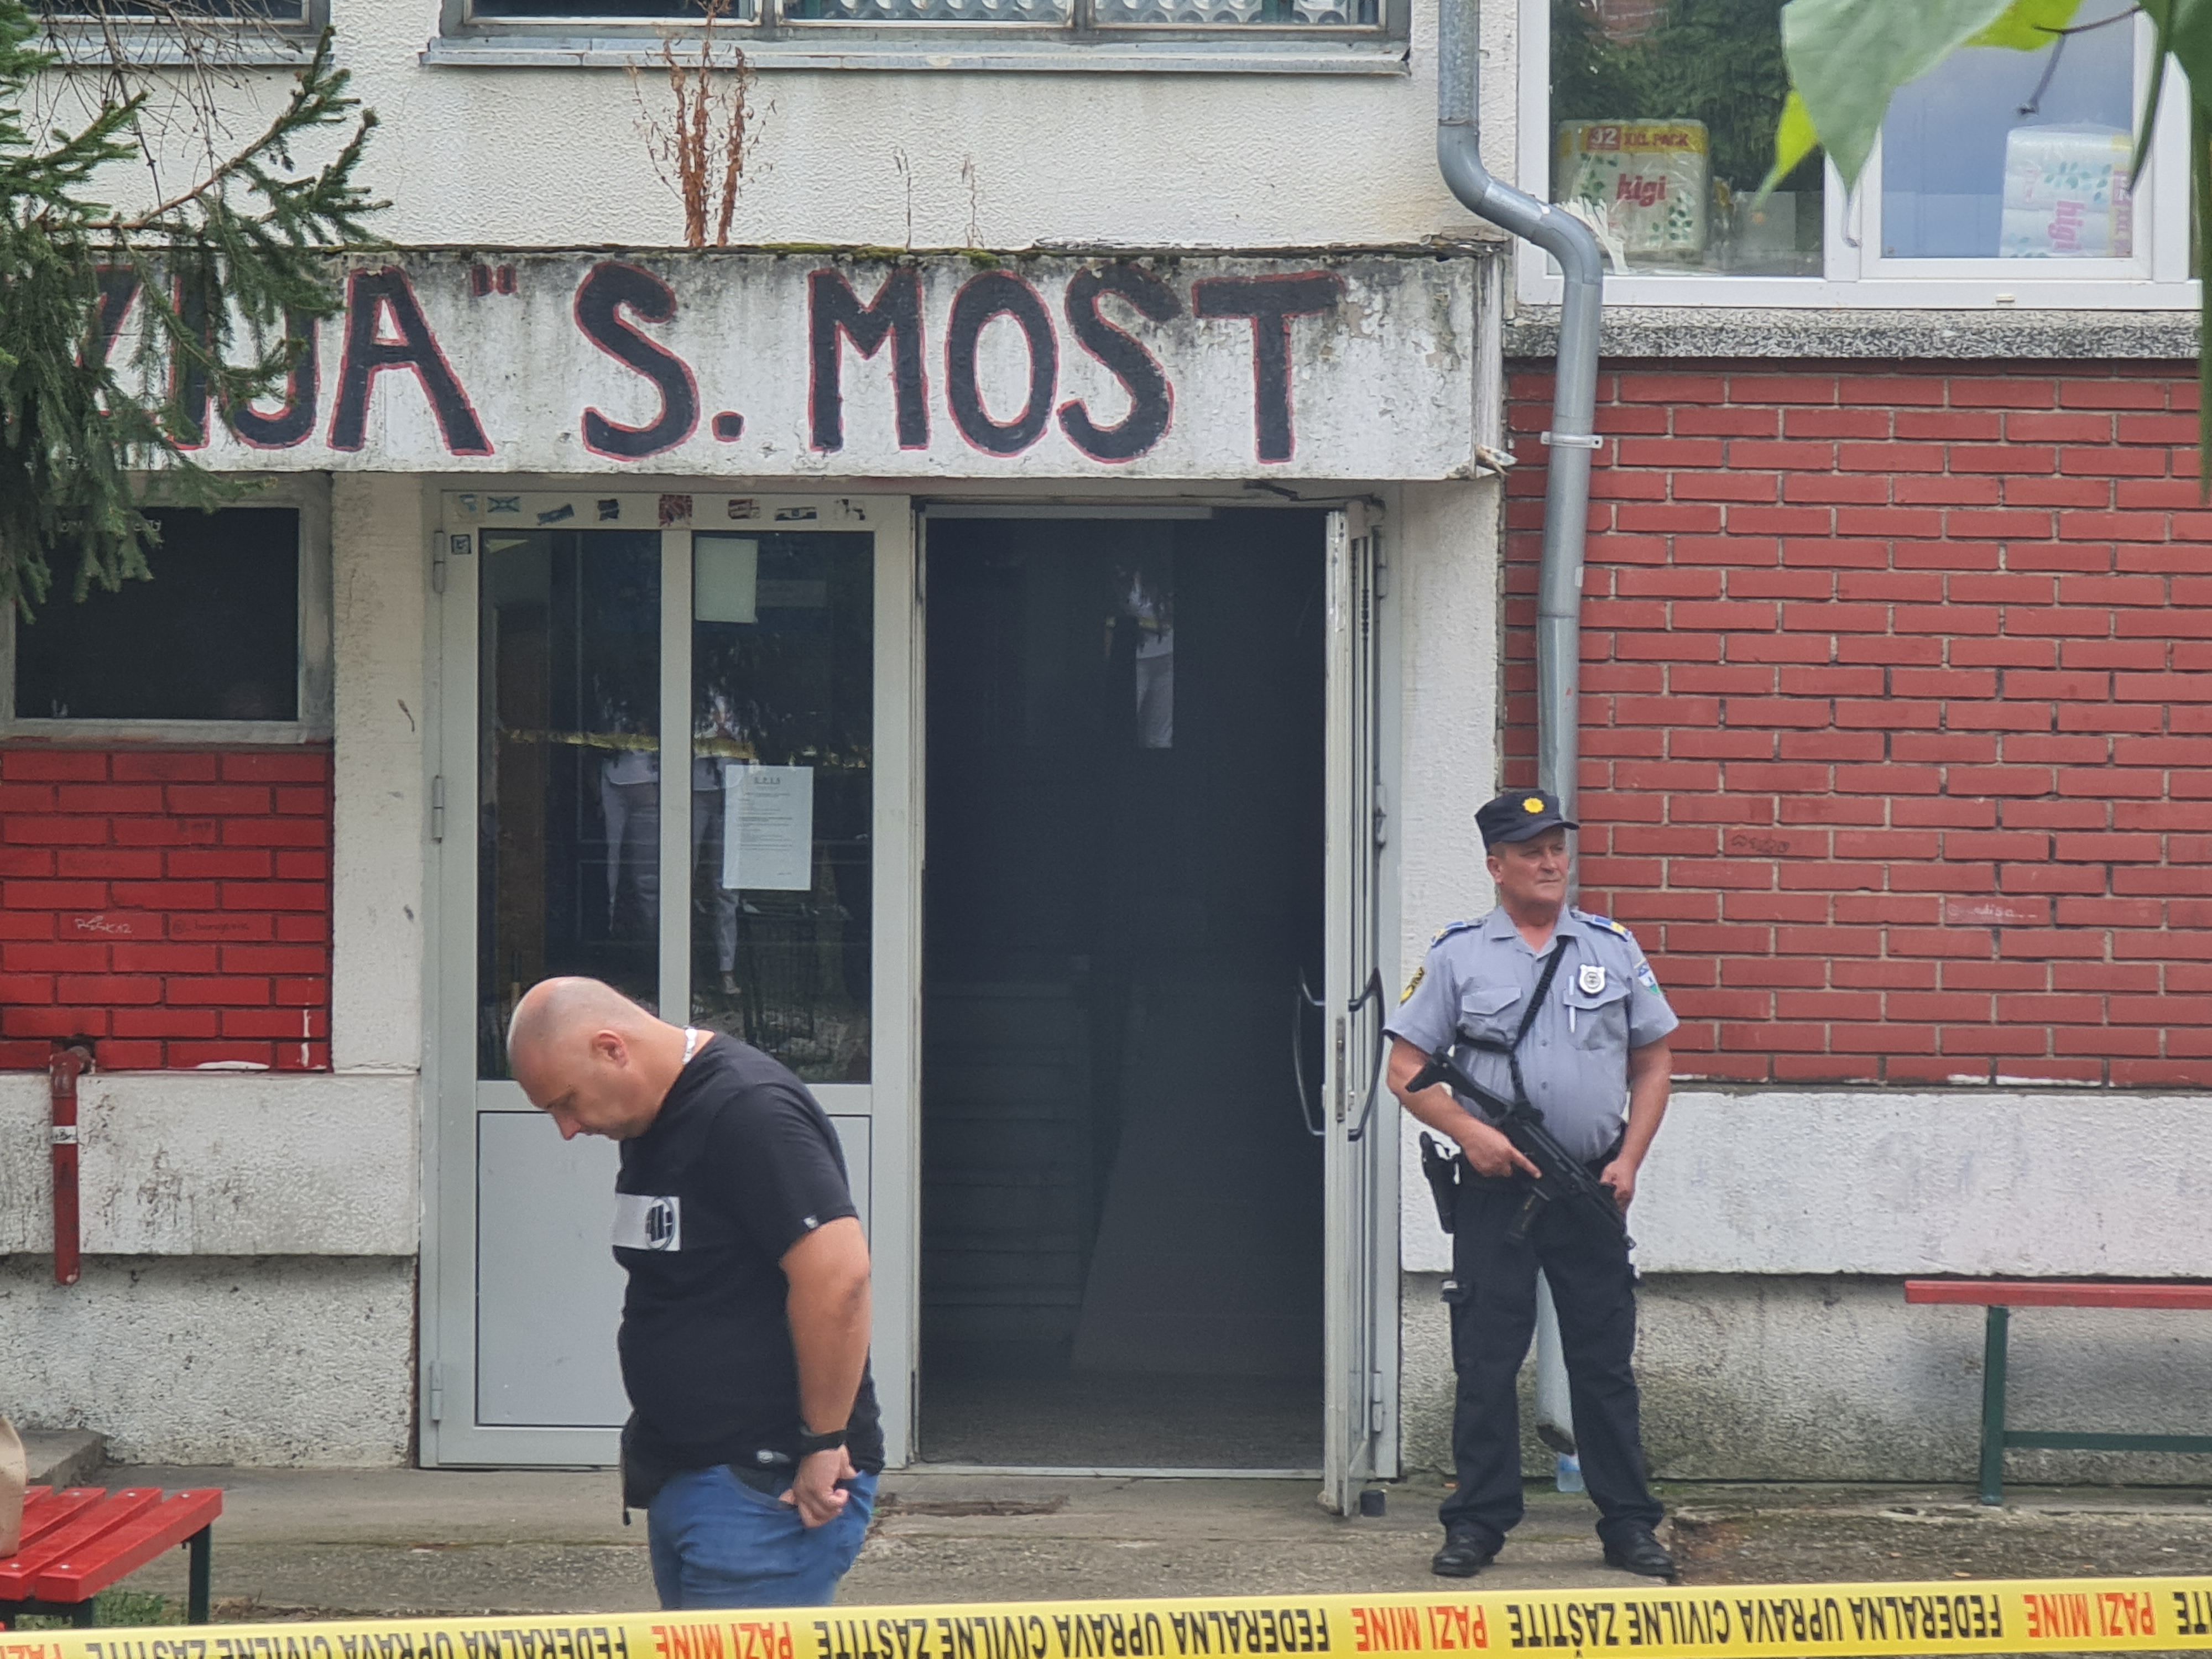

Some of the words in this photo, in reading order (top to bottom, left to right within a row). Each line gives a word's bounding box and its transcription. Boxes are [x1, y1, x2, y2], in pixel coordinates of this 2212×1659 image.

[1590, 127, 1618, 145] 32
[2047, 200, 2086, 249] higi
[573, 260, 745, 462] S.
[807, 261, 1345, 465] MOST
[934, 1615, 1048, 1659] CIVILNE
[1051, 1611, 1165, 1656] UPRAVA
[1167, 1608, 1331, 1655] FEDERALNA
[1350, 1606, 1422, 1652] MINE
[1426, 1604, 1489, 1651] PAZI
[1506, 1602, 1620, 1658] ZAŠTITE
[1624, 1599, 1730, 1646] CIVILNE
[1735, 1597, 1843, 1643] UPRAVA
[1847, 1594, 2005, 1641] FEDERALNA
[2022, 1593, 2092, 1637] MINE
[2095, 1592, 2157, 1636] PAZI
[460, 1626, 627, 1659] FEDERALNA
[651, 1624, 725, 1659] MINE
[729, 1621, 794, 1659] PAZI
